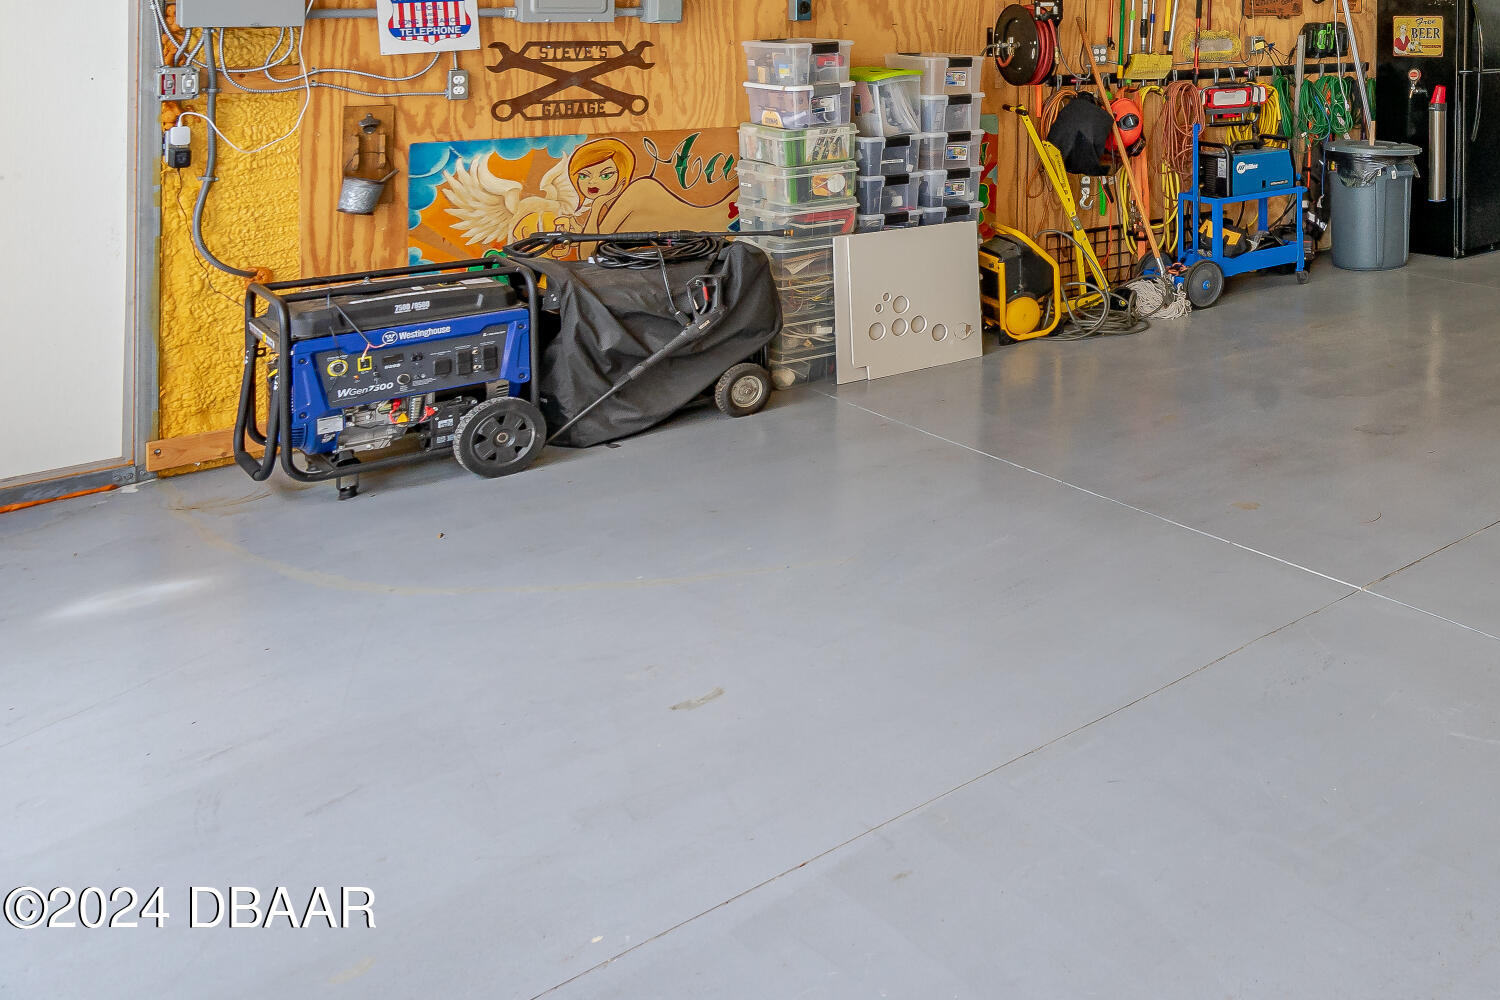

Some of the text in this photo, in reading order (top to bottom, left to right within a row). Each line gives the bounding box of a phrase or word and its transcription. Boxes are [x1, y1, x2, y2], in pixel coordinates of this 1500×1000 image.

[400, 26, 462, 36] TELEPHONE
[1411, 27, 1441, 39] BEER
[539, 45, 608, 60] STEVE'S
[541, 100, 607, 116] GARAGE
[399, 325, 451, 340] Westinghouse
